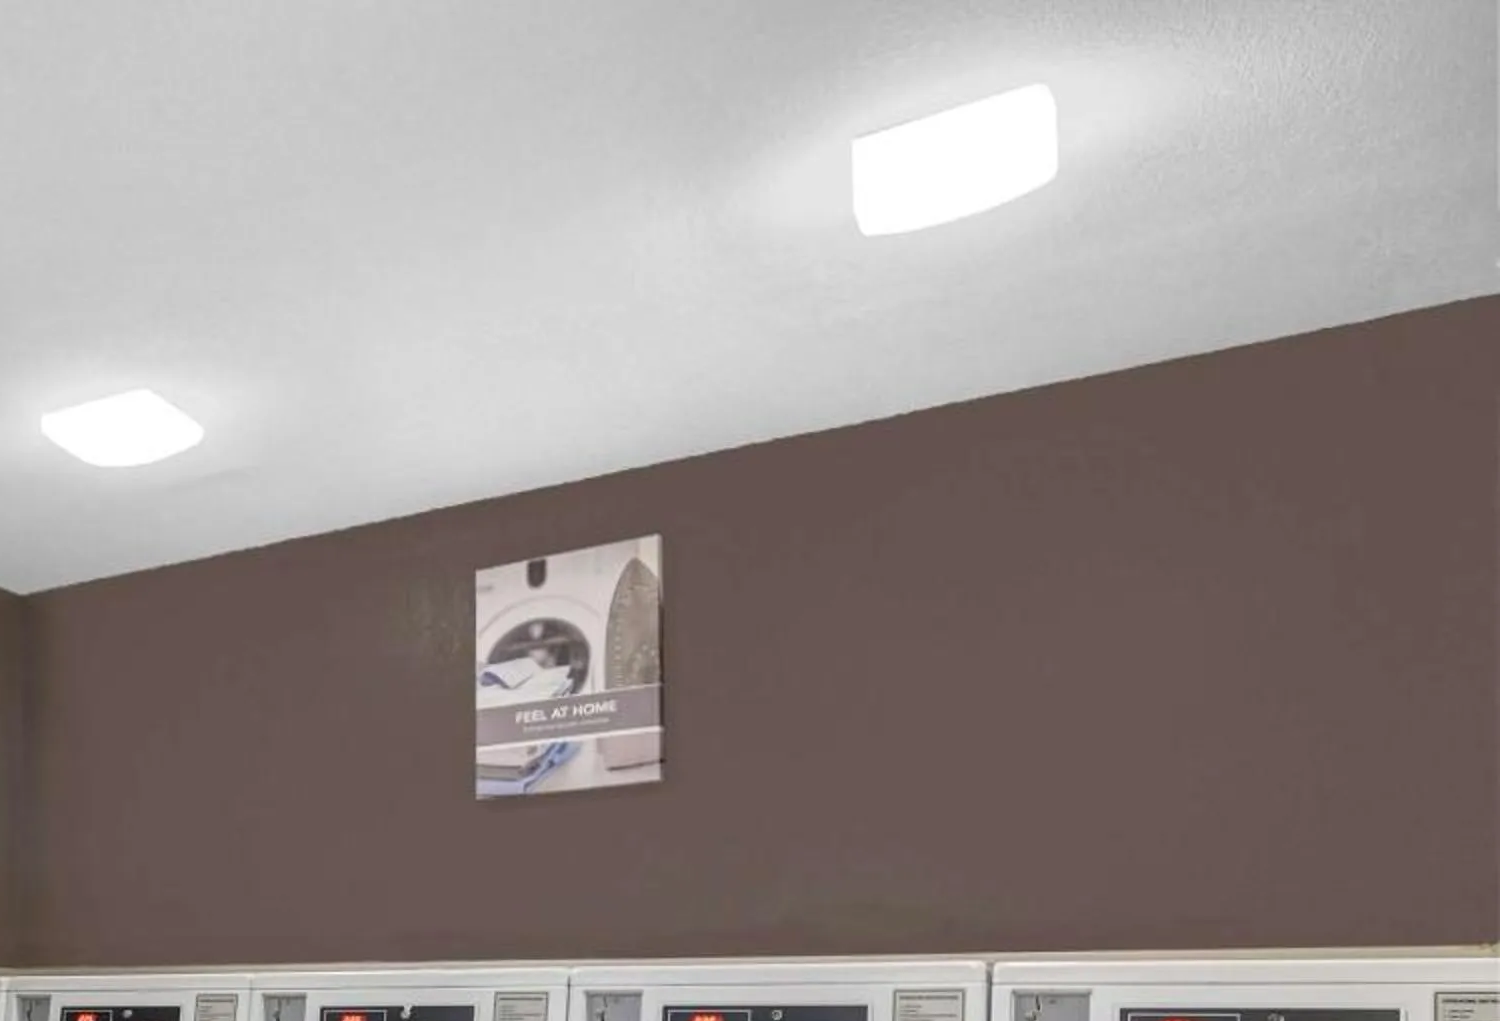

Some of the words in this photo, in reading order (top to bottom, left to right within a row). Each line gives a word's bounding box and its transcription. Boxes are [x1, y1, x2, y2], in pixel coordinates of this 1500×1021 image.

[515, 709, 547, 724] FEEL
[551, 705, 569, 720] AT
[573, 699, 617, 717] HOME
